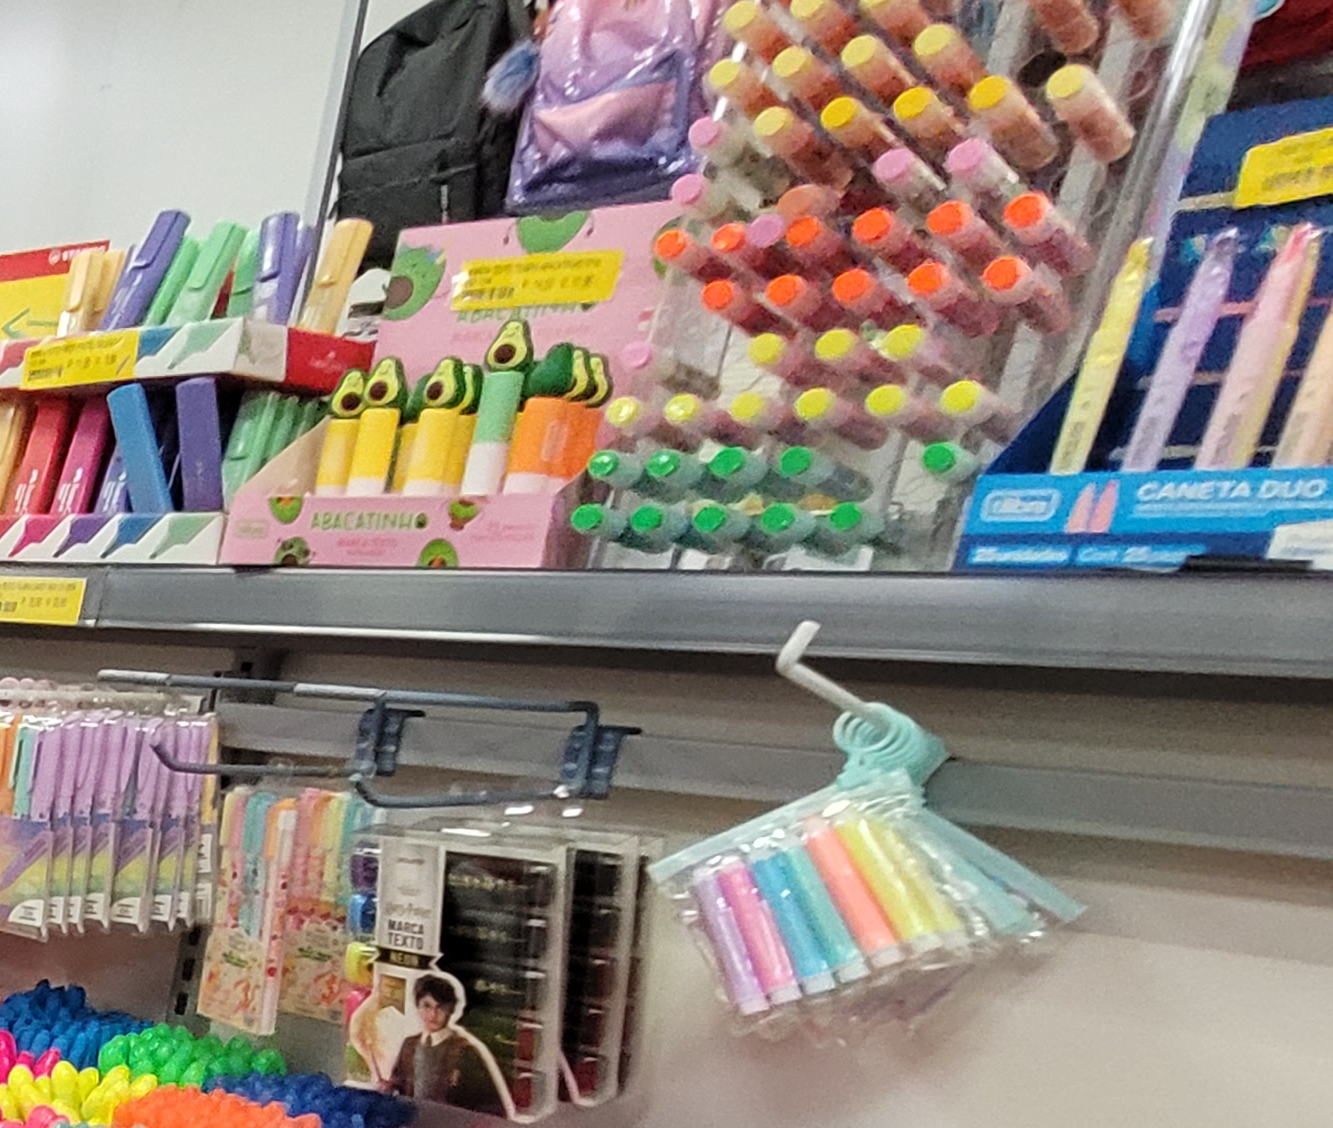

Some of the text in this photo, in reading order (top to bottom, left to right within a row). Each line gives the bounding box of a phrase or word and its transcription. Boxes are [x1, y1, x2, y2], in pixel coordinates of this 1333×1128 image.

[1136, 480, 1253, 501] CANETA
[1257, 478, 1329, 499] DUO
[388, 919, 425, 935] MARCA
[388, 932, 424, 950] TEXTO
